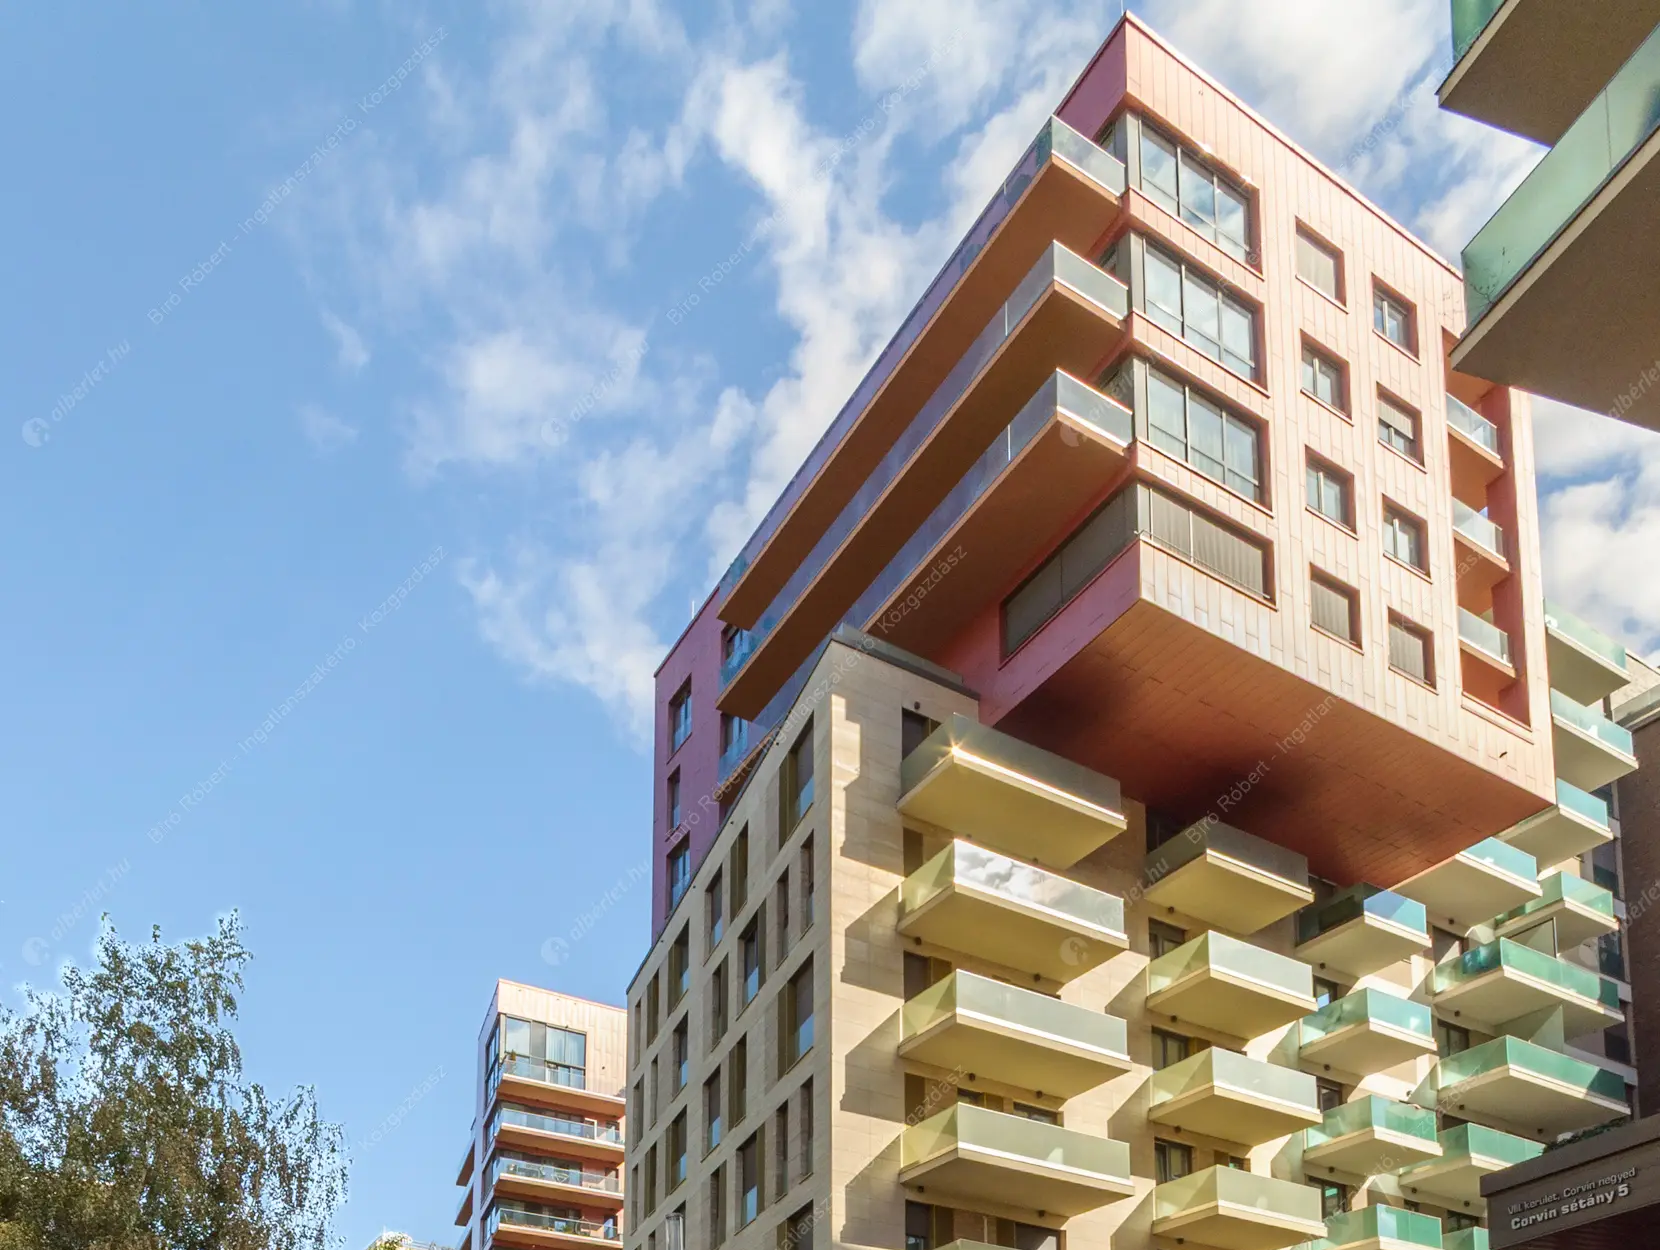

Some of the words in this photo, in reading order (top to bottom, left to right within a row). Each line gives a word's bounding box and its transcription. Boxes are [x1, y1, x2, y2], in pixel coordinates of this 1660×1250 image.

[1563, 1180, 1595, 1198] Corvin
[1599, 1167, 1636, 1186] negyed
[1511, 1208, 1557, 1230] Corvin
[1561, 1189, 1615, 1215] sétány
[1618, 1183, 1630, 1197] 5
